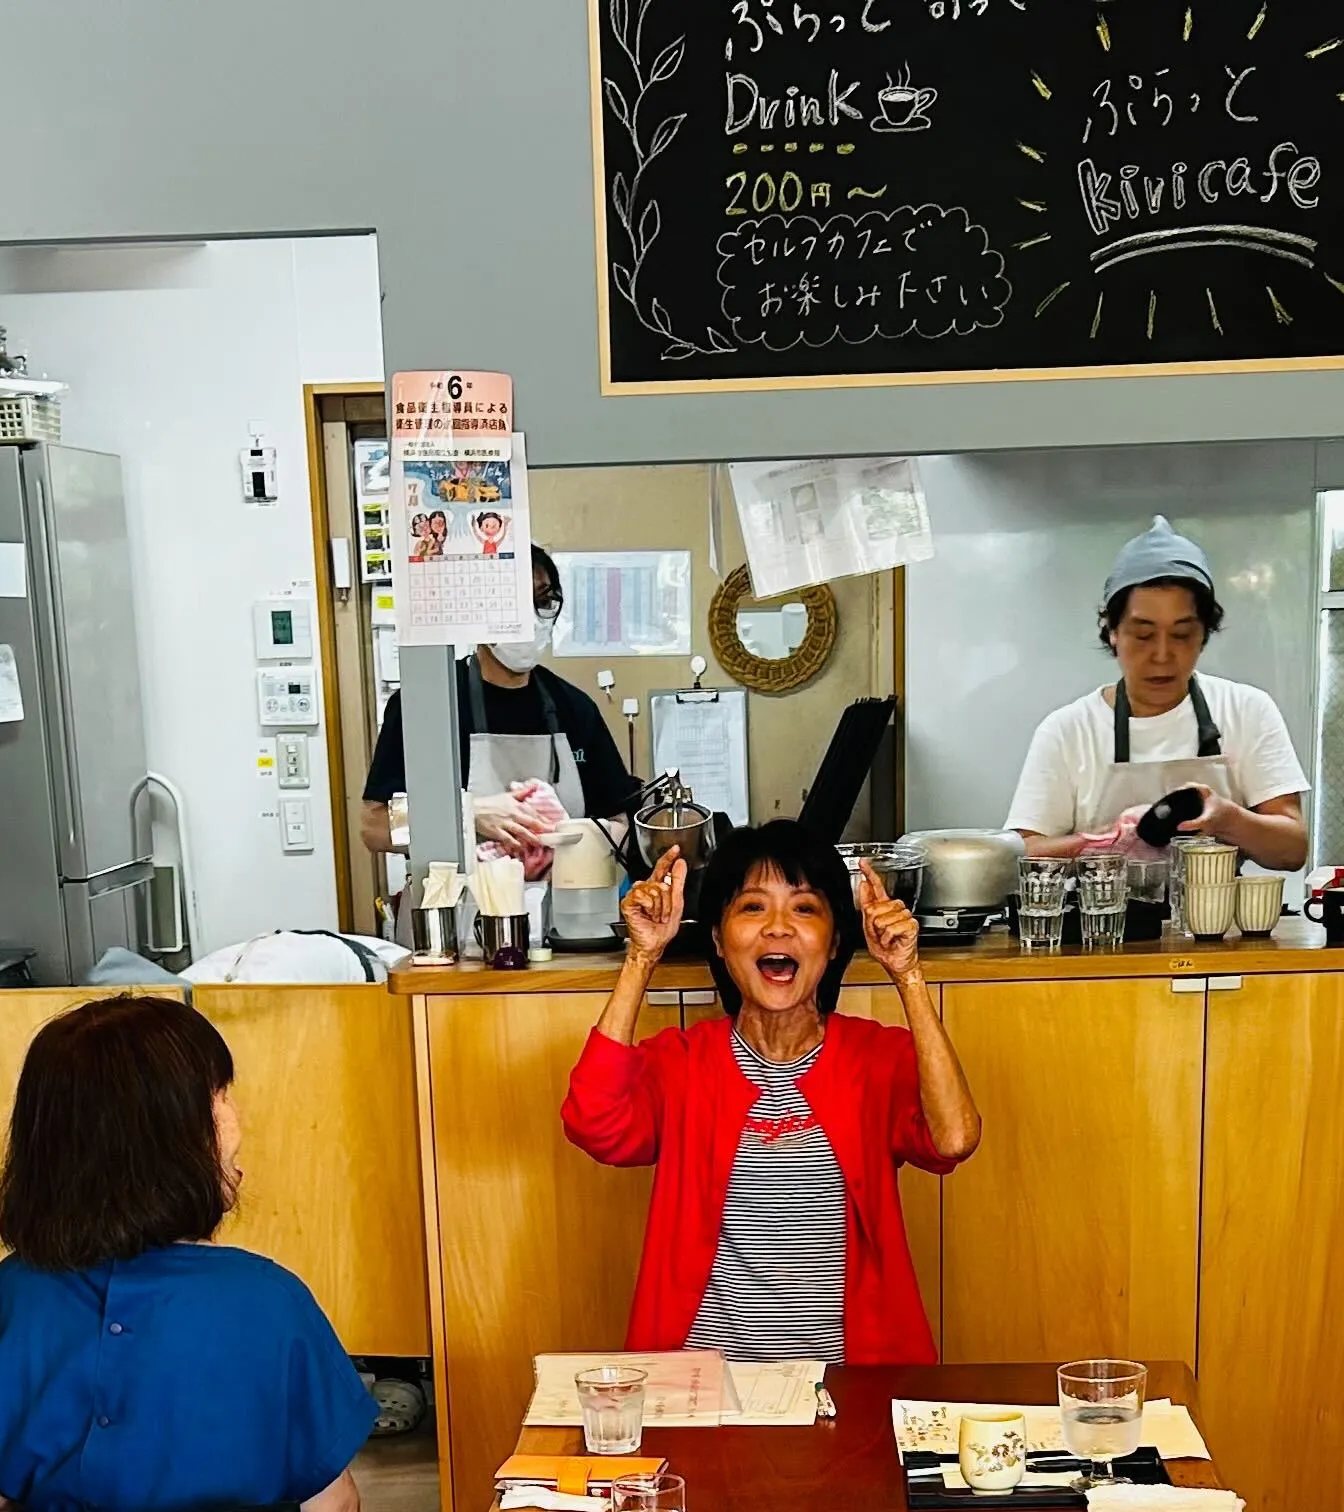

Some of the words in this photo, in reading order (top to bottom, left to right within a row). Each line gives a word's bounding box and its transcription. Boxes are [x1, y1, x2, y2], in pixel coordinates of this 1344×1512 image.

[725, 68, 863, 135] Drink
[744, 219, 933, 261] セルフカフェで
[758, 270, 992, 317] お楽しみ下さい
